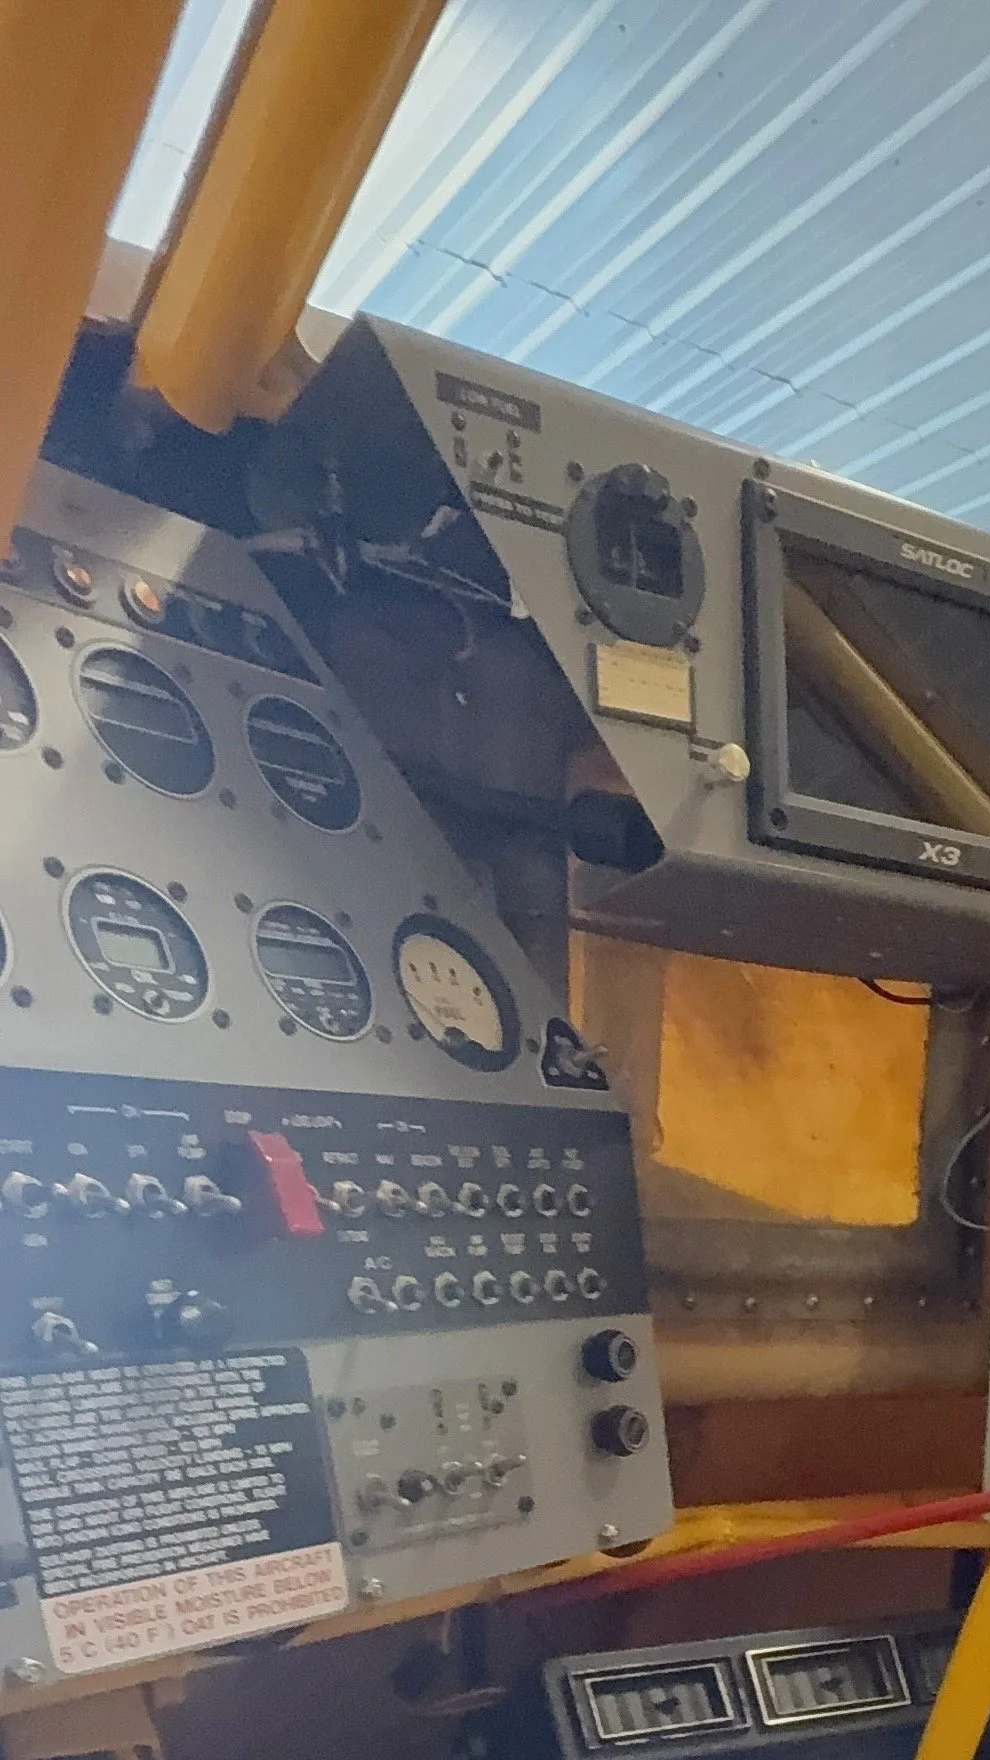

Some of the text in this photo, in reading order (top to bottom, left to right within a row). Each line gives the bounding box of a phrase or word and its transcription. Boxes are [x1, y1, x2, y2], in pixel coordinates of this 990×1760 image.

[900, 542, 974, 578] SATLOC
[918, 841, 961, 866] X3
[53, 1582, 168, 1619] OPERATION
[173, 1576, 198, 1595] OF
[206, 1567, 247, 1587] THIS
[255, 1549, 333, 1577] AIRCRAFT
[64, 1569, 333, 1641] IN VISIBLE MOISTURE BELOW
[180, 1614, 216, 1636] OAT
[222, 1609, 242, 1626] IS
[246, 1585, 346, 1619] PROHIBITED
